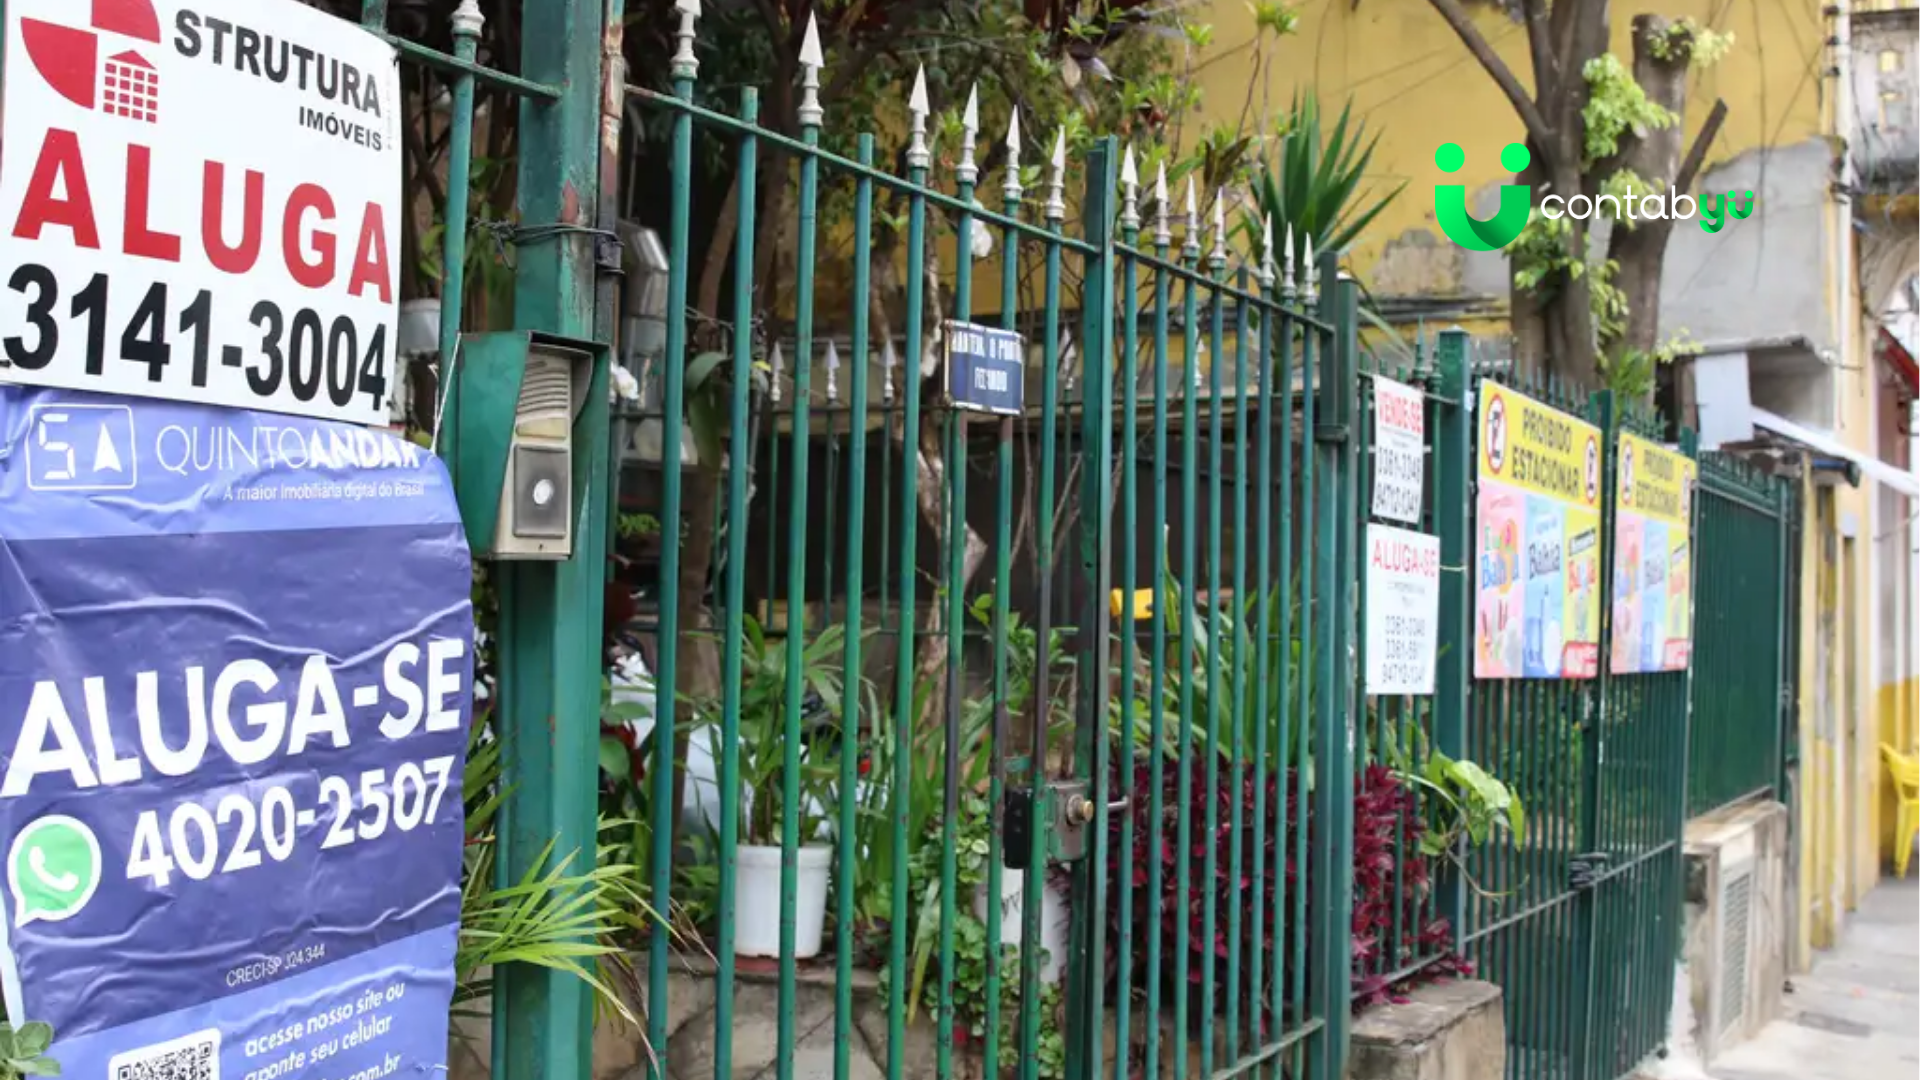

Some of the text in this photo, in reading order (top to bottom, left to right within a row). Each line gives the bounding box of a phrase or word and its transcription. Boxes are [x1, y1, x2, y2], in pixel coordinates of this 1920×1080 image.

[173, 9, 381, 118] STRUTURA
[299, 106, 382, 151] IMÓVEIS
[12, 127, 393, 304] ALUGA
[3, 263, 387, 412] 3141-3004
[1523, 407, 1572, 454] PROIBIDO
[237, 484, 278, 501] maior
[378, 481, 392, 498] do
[1511, 445, 1580, 499] ESTACIONAR
[1372, 538, 1437, 578] ALUGA-SE
[2, 637, 465, 797] ALUGA-SE
[126, 756, 457, 889] 4020-2507
[226, 955, 283, 988] CRECI-SP
[245, 982, 406, 1057] acesse nosso site ou
[309, 1038, 339, 1064] seu
[342, 1014, 393, 1050] celular
